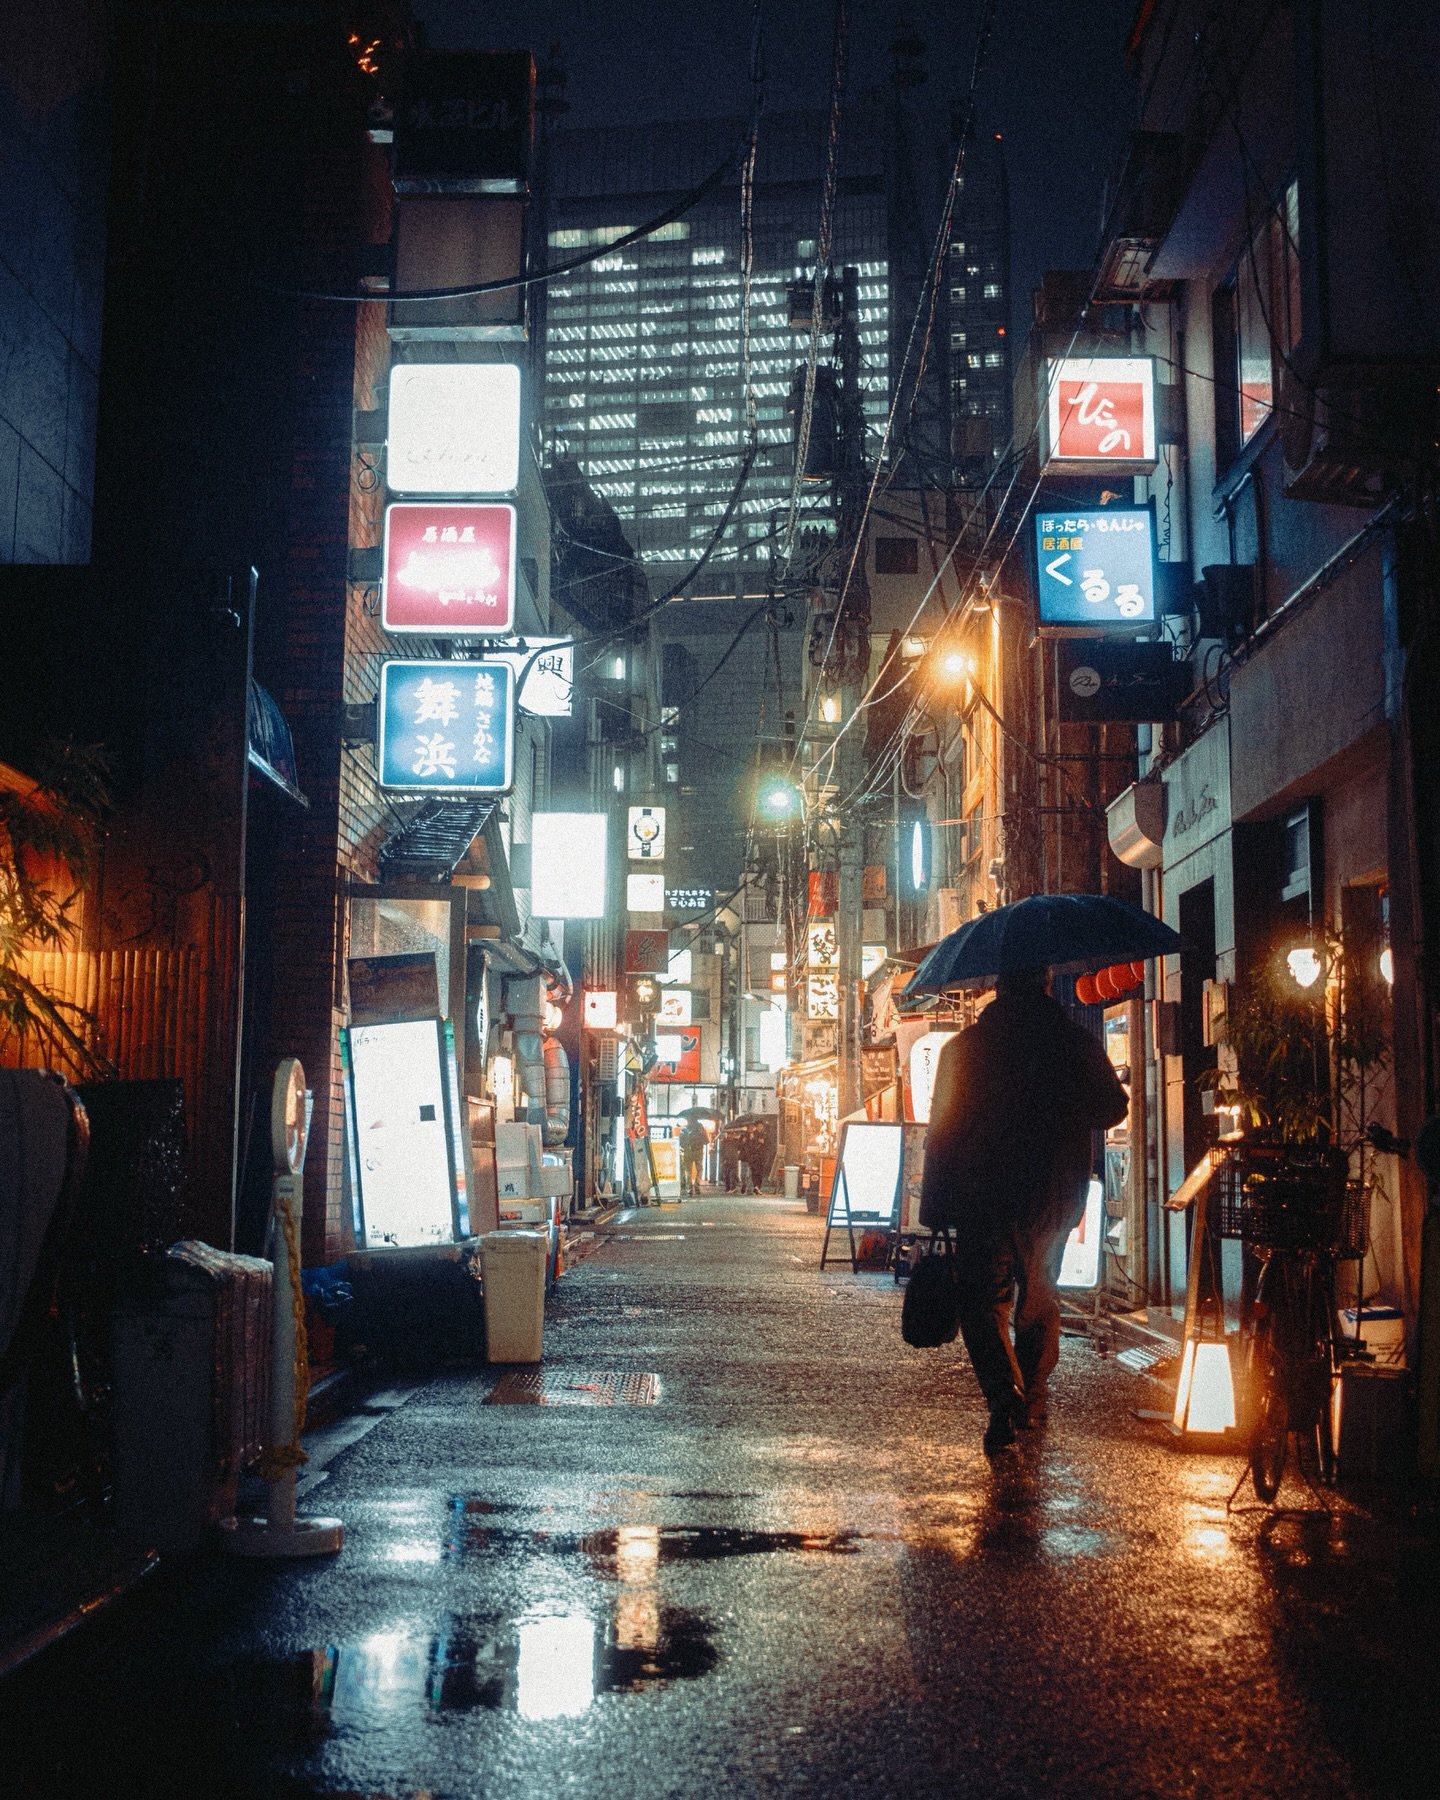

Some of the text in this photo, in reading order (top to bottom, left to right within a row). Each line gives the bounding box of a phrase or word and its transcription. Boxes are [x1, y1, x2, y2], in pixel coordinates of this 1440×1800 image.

[1042, 537, 1083, 550] 居酒屋
[1045, 553, 1145, 618] くるる
[412, 678, 462, 779] 舞浜
